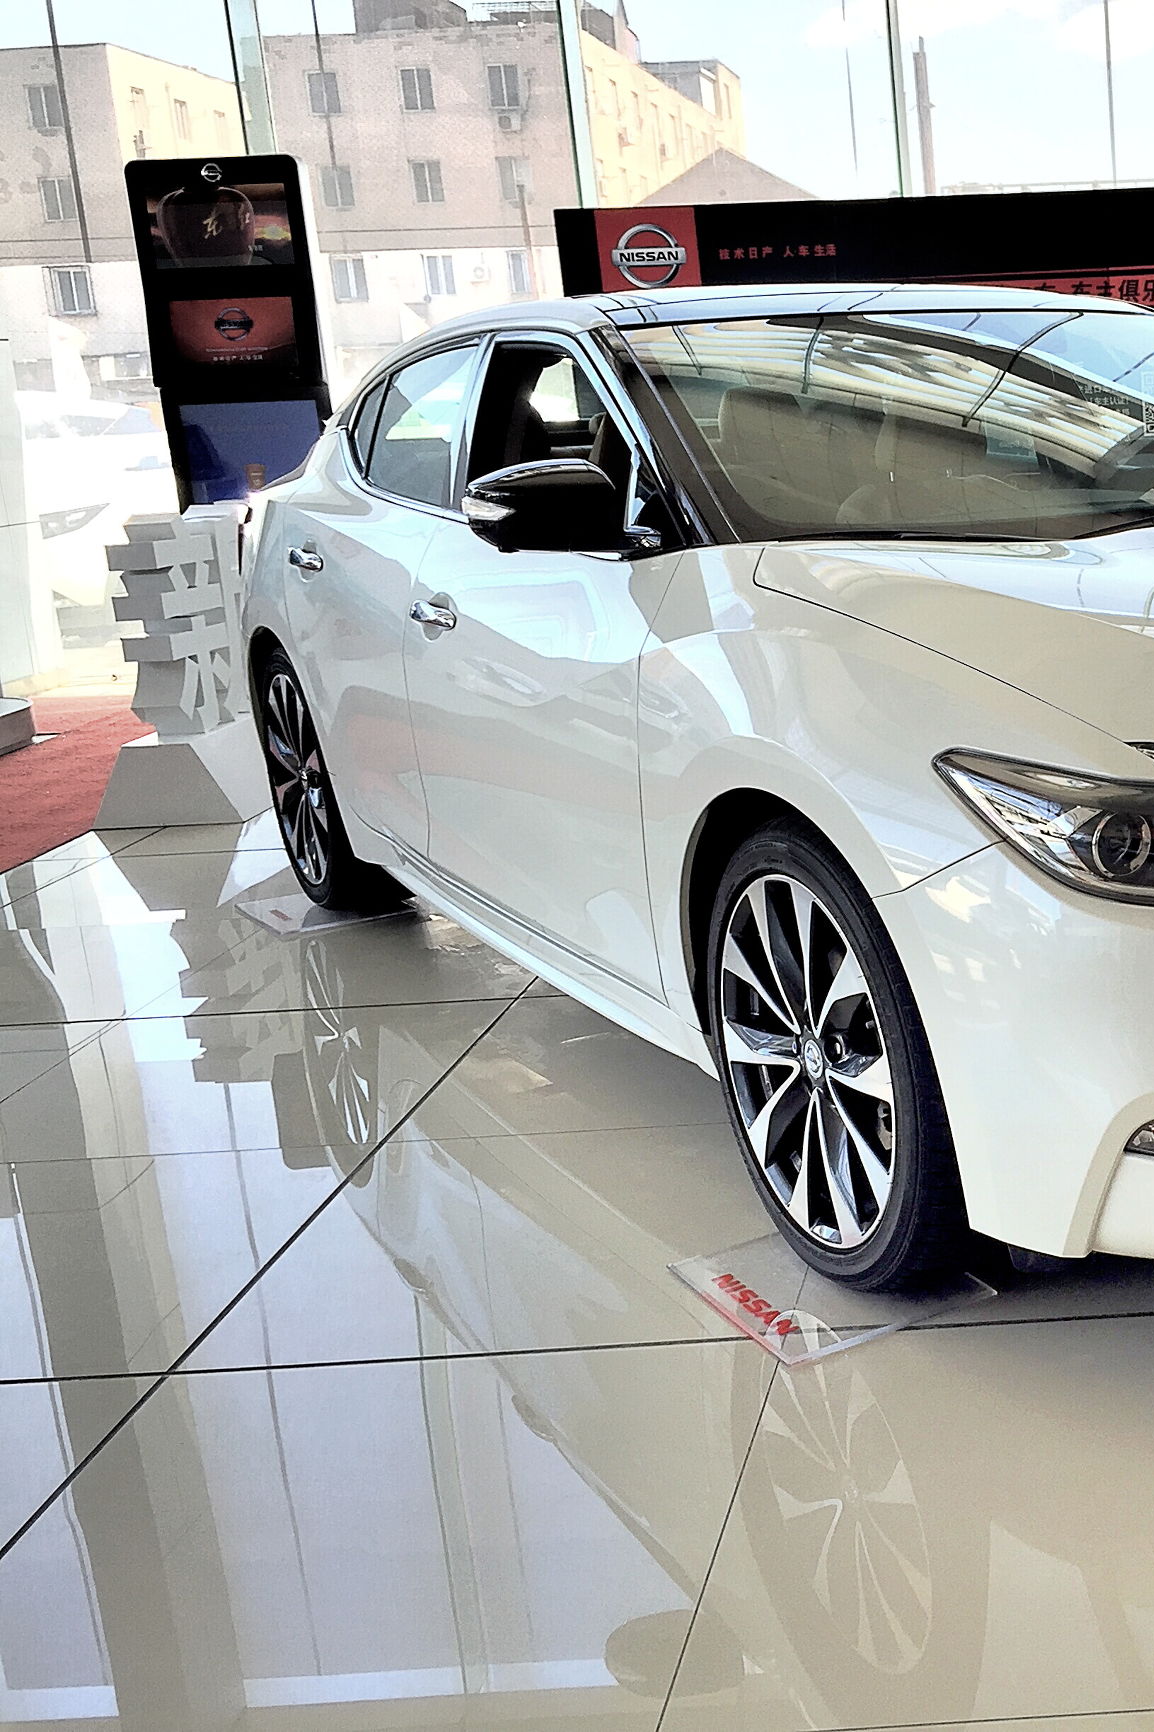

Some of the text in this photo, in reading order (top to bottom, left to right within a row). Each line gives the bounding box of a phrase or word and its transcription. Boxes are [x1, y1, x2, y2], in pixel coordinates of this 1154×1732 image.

[619, 251, 679, 262] NISSAN
[718, 246, 773, 260] 技术日产
[711, 1273, 799, 1336] NISSAN
